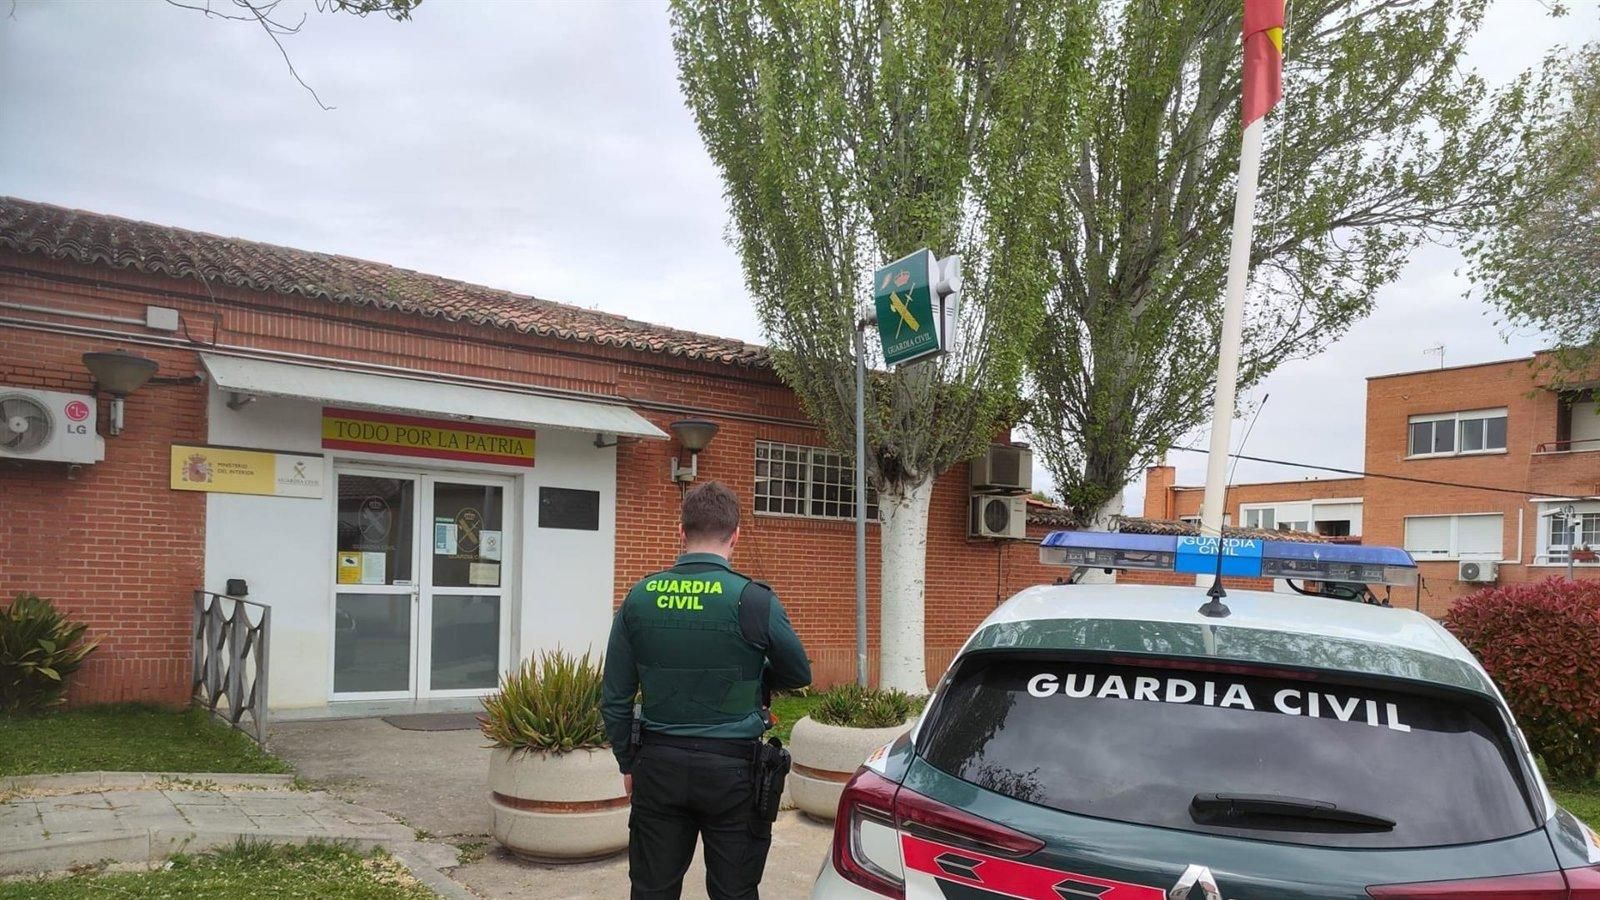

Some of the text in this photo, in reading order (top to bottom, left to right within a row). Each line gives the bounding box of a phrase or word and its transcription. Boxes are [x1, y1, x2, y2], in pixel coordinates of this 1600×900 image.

[888, 332, 931, 354] GUARDIA CIVIL
[67, 424, 87, 434] LG
[335, 420, 525, 456] TODO POR LA PATRIA
[1183, 536, 1256, 549] GUARDIA
[1198, 545, 1239, 556] CIVIL
[646, 580, 722, 594] GUARDIA
[657, 595, 703, 610] CIVIL
[1027, 673, 1411, 732] GUARDIA CIVIL
